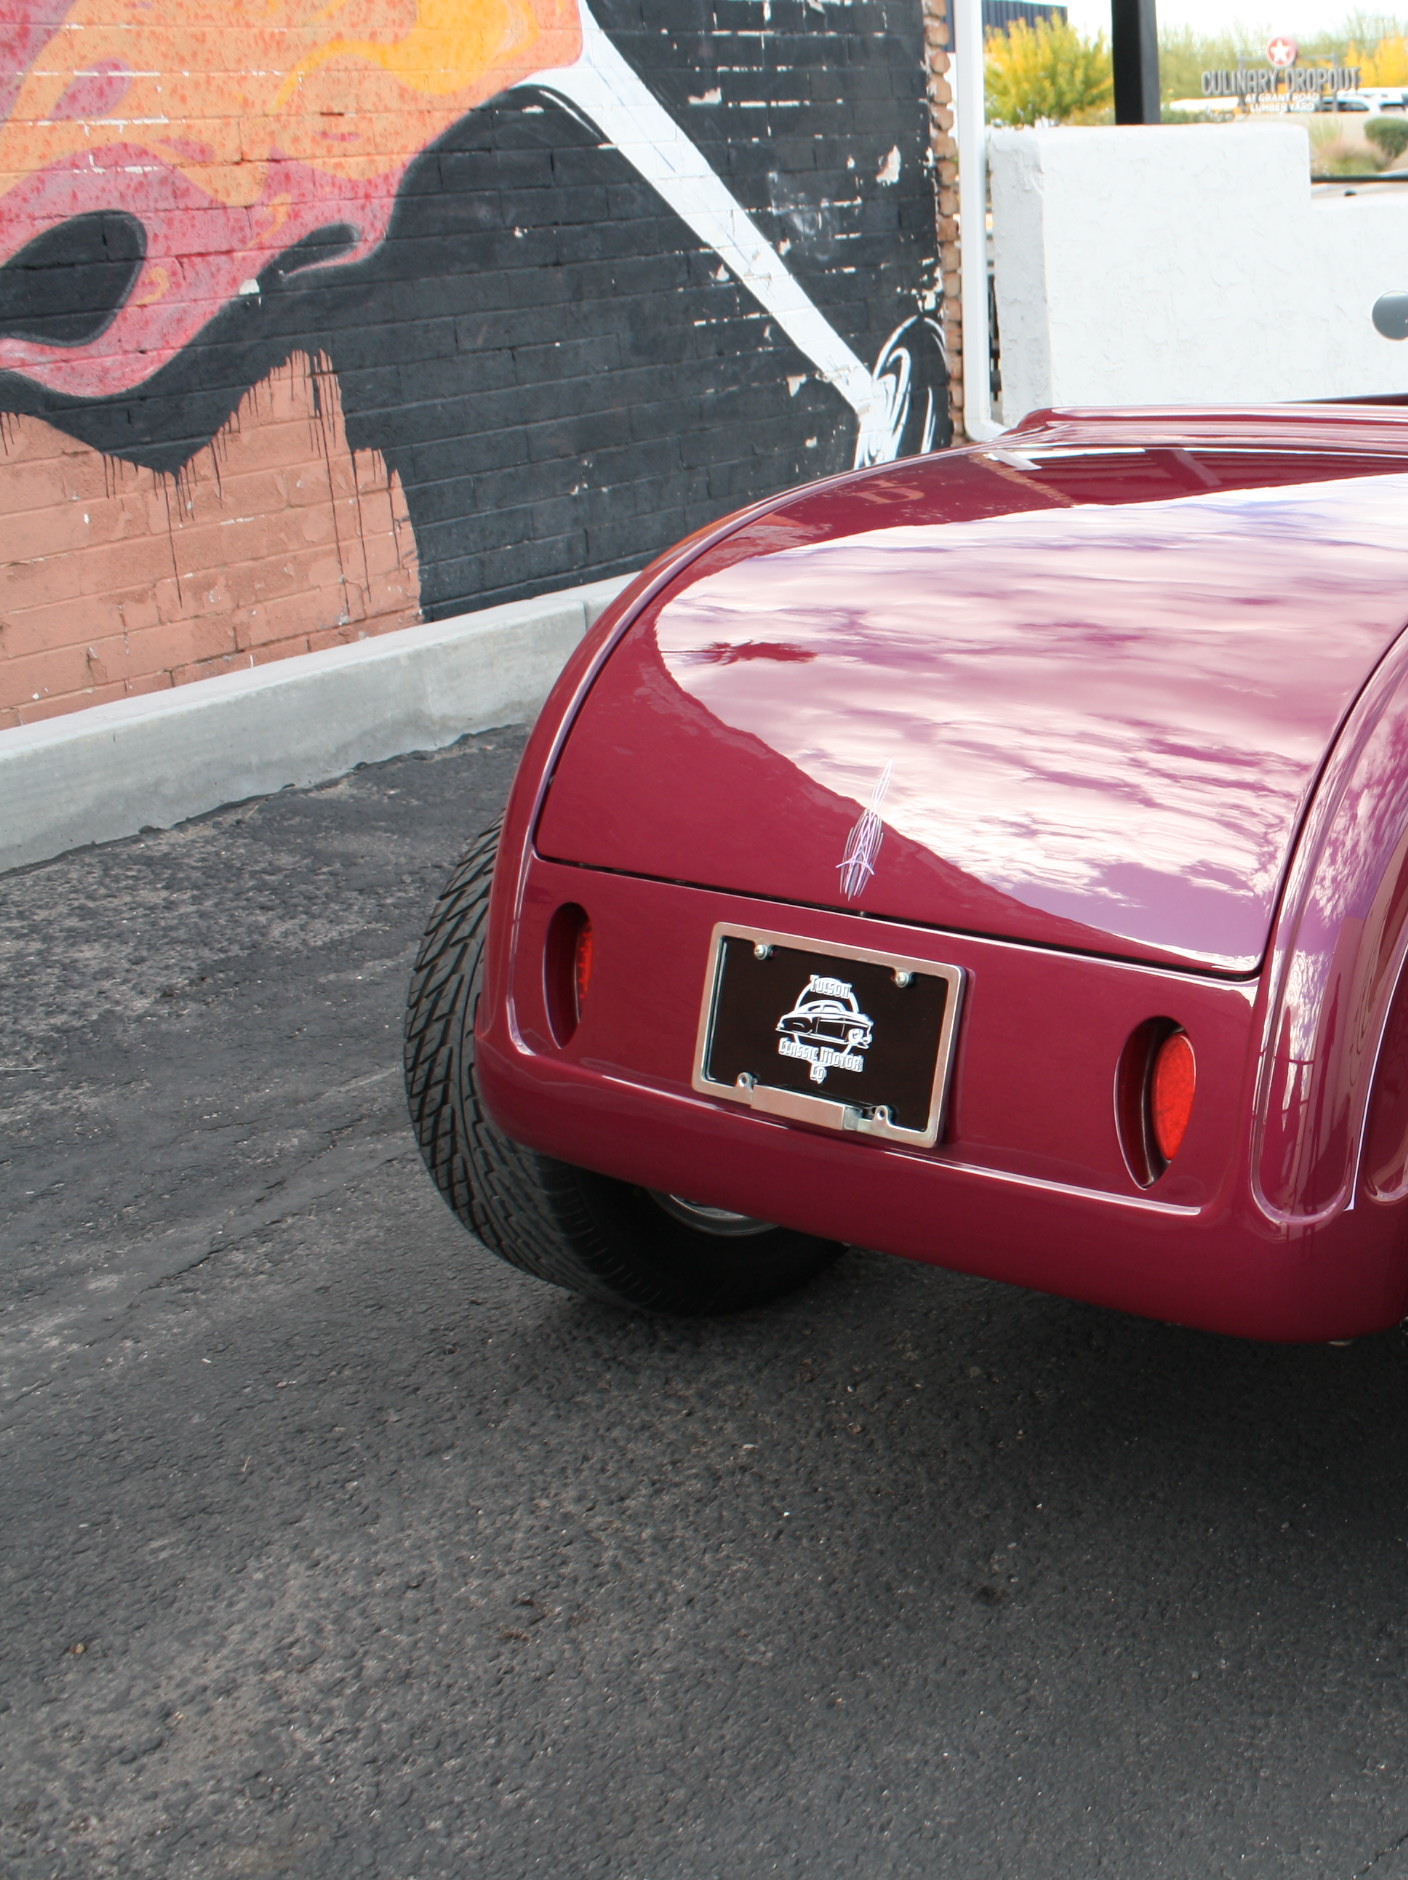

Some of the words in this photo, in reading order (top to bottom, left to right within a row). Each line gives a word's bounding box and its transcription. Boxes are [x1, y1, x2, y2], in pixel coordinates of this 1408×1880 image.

[1201, 68, 1278, 95] CULINARY
[1284, 66, 1362, 93] DROPOUT
[1245, 93, 1257, 104] AT
[1258, 92, 1290, 104] GRANT
[1292, 92, 1319, 104] ROAD
[1250, 103, 1287, 114] LUMBER
[1289, 102, 1316, 113] YARD
